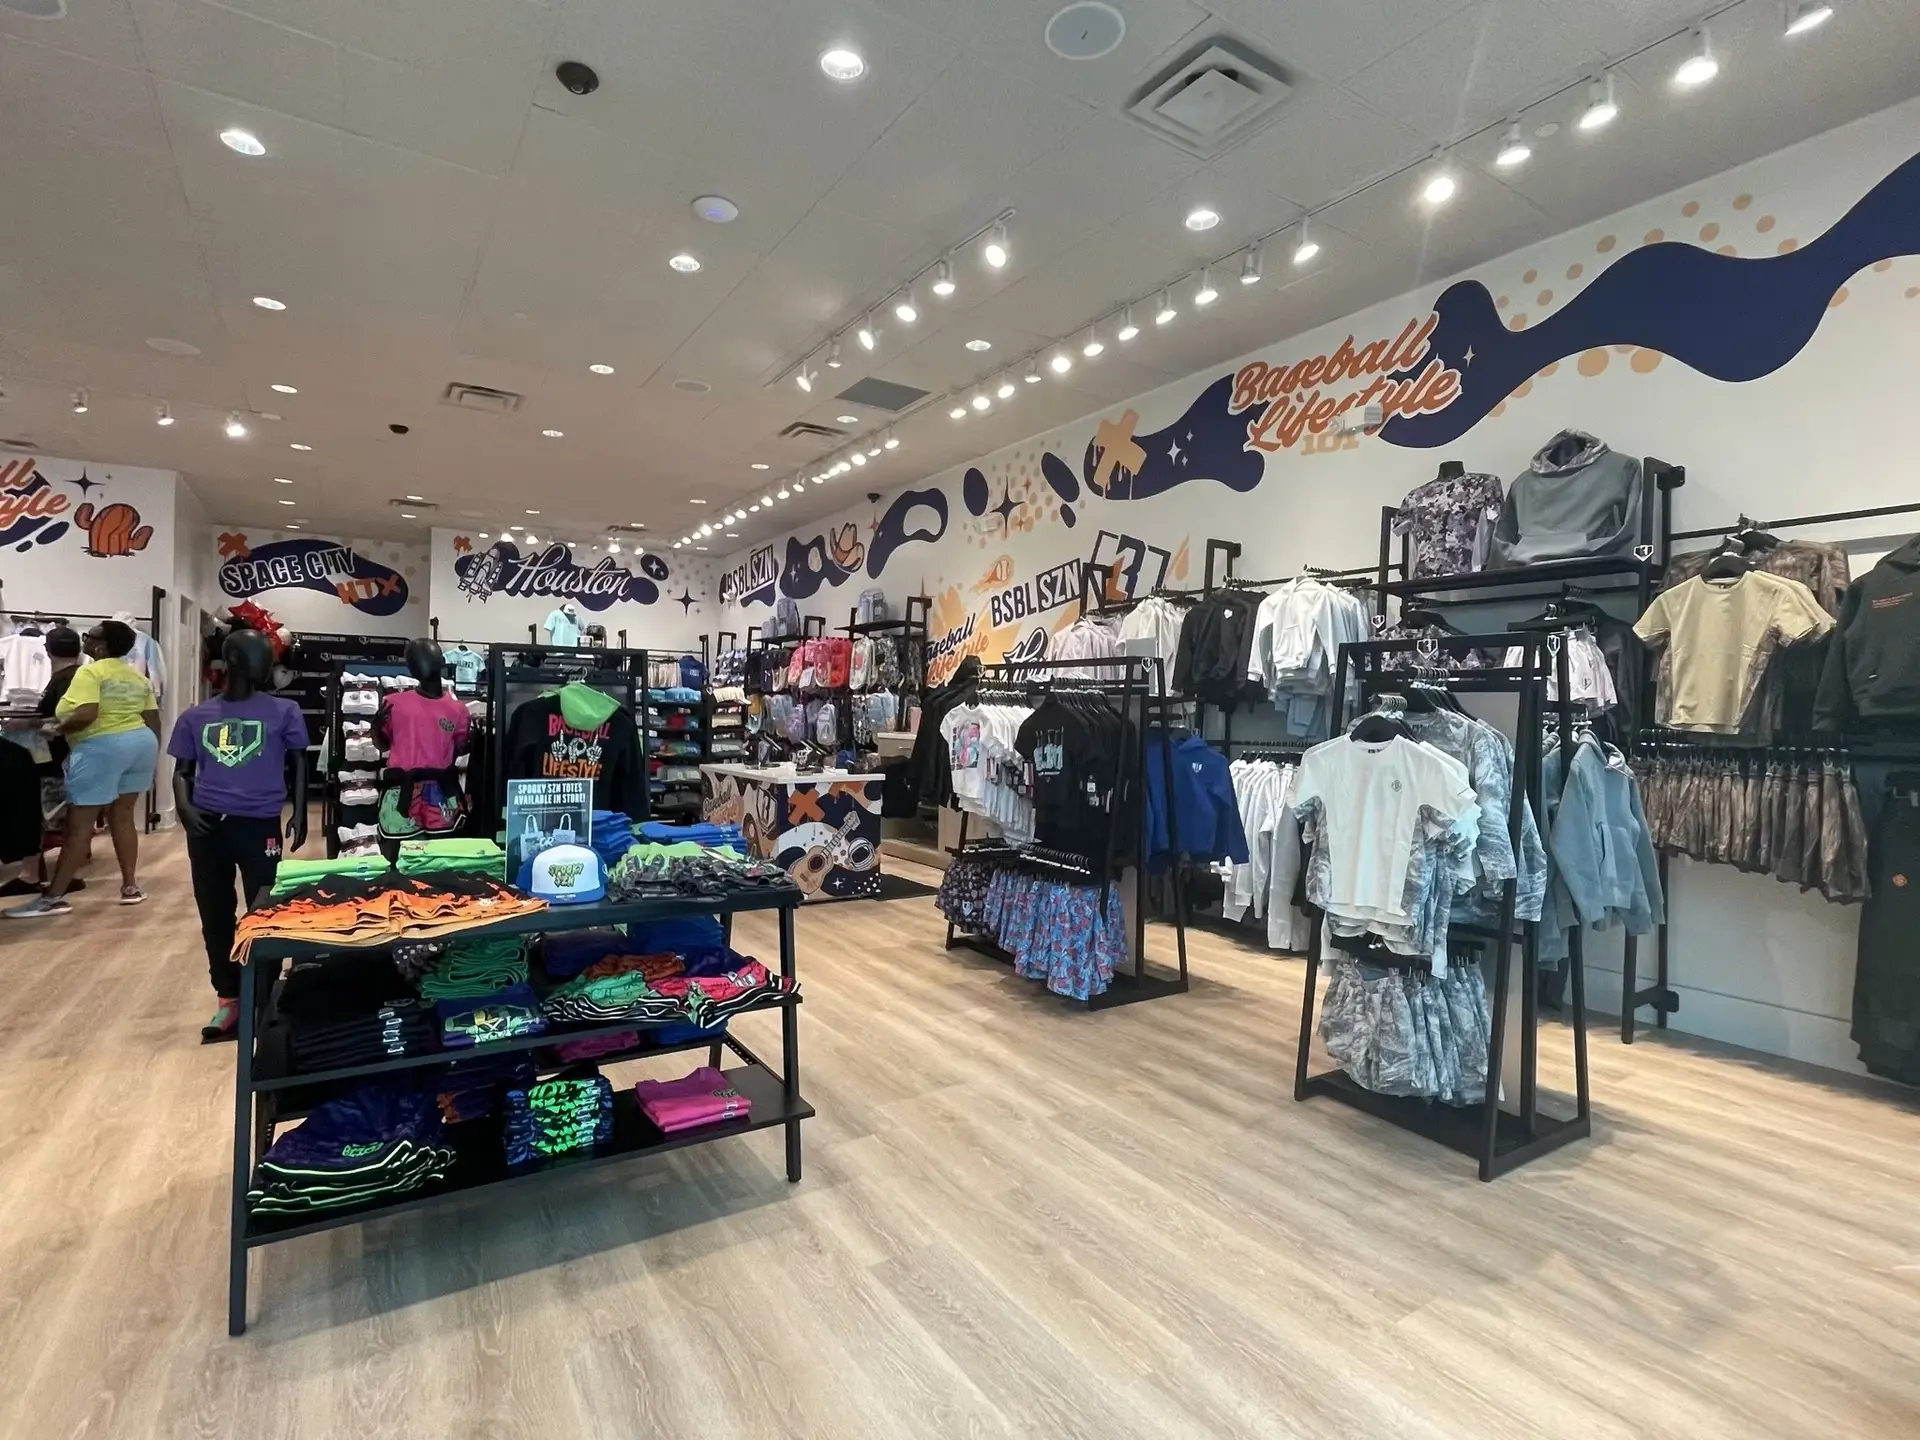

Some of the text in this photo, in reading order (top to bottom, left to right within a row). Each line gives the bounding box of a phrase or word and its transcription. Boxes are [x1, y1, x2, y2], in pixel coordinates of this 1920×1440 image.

[1231, 312, 1438, 411] Baseball
[220, 546, 356, 594] SPACE CITY
[336, 574, 401, 605] HTX
[504, 543, 631, 597] Houston
[925, 612, 976, 661] aseball
[513, 792, 586, 806] AVAILABLE IN STORE!
[517, 782, 583, 795] SPOOKY SZN TOTES
